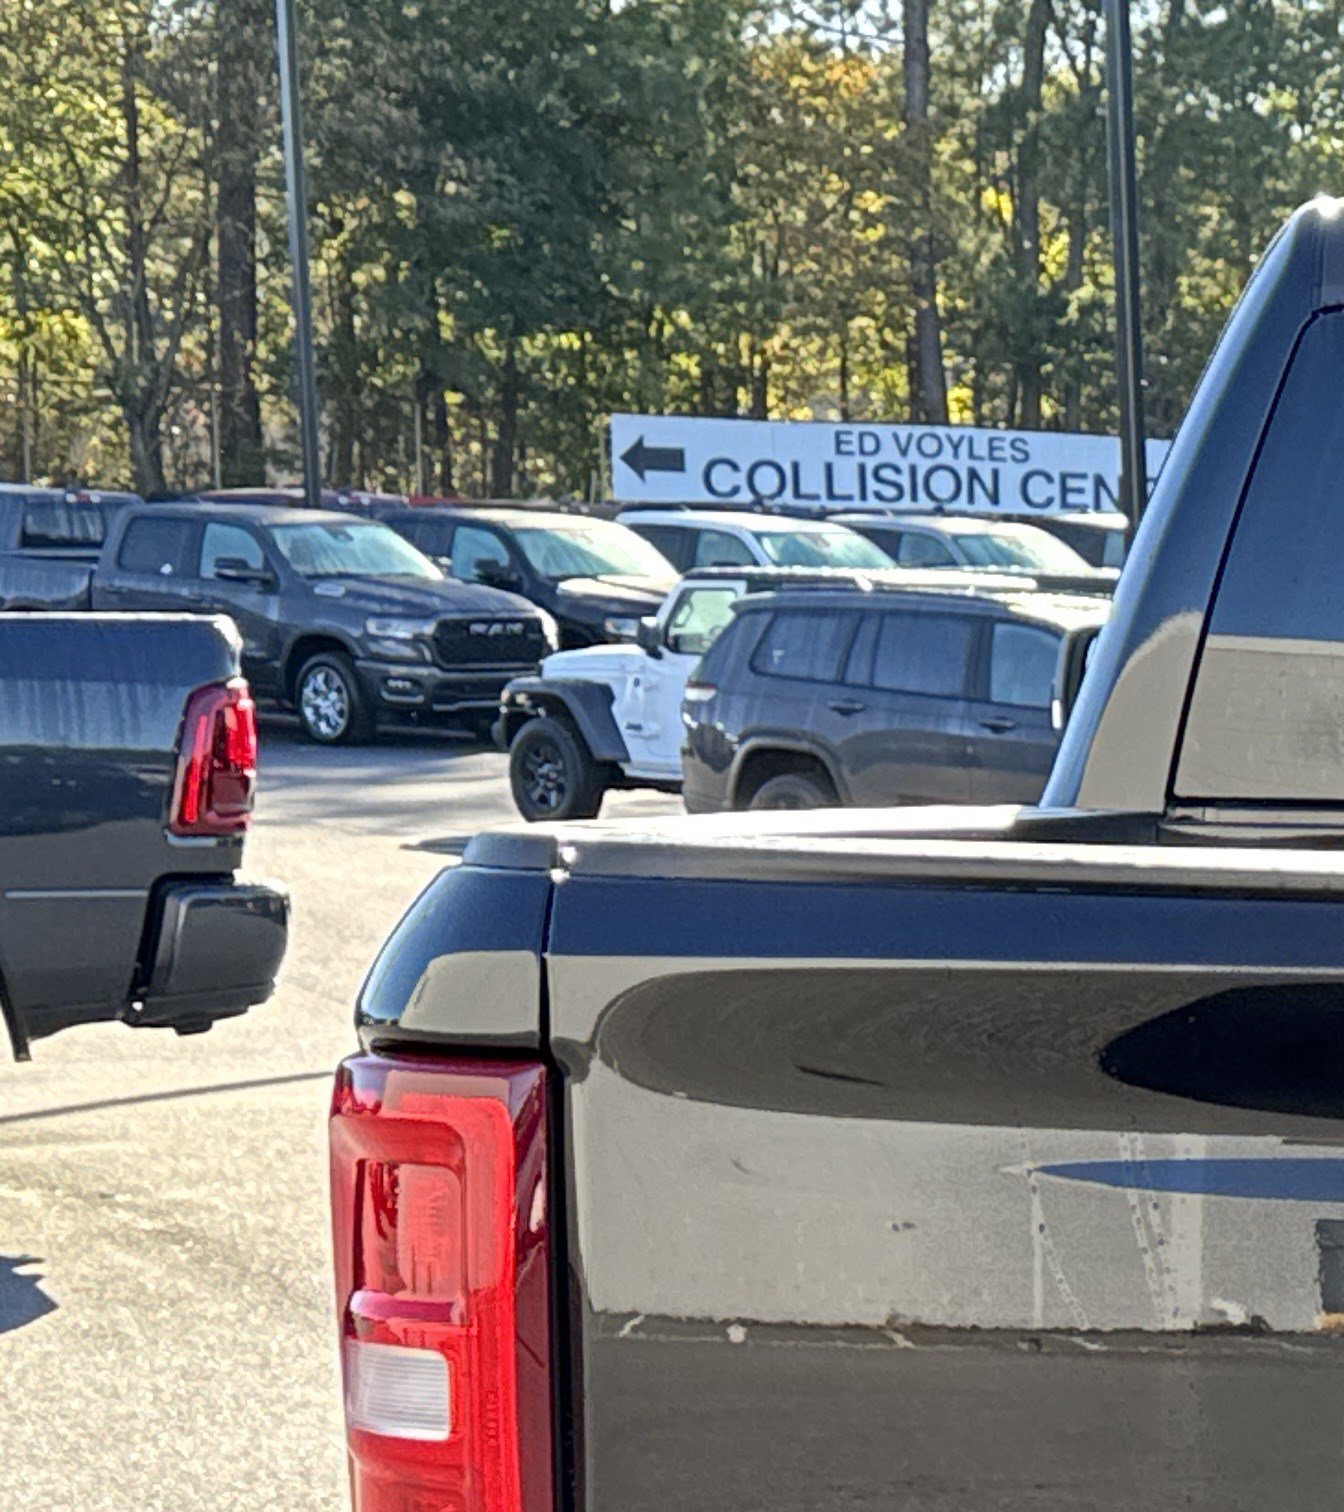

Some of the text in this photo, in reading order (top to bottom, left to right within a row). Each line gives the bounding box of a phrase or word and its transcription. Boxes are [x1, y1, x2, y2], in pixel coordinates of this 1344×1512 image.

[834, 430, 1031, 464] ED VOYLES
[701, 457, 1157, 511] COLLISION CEN
